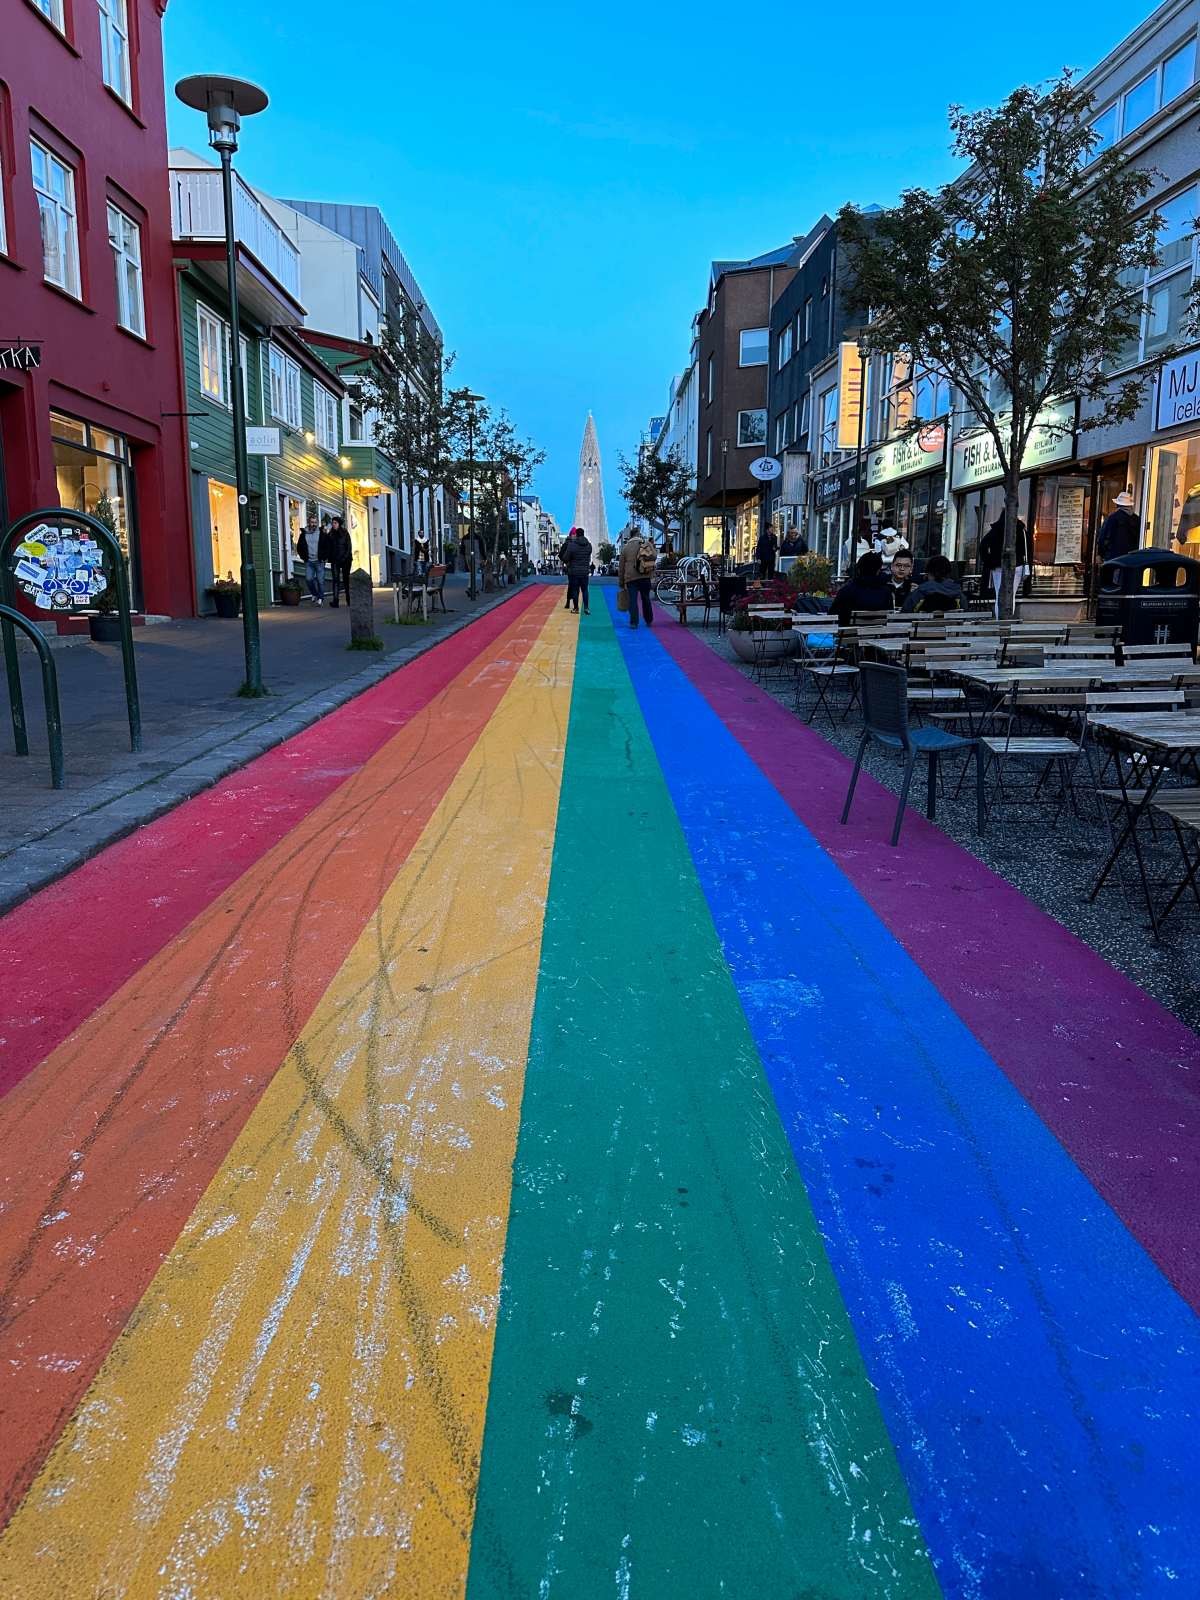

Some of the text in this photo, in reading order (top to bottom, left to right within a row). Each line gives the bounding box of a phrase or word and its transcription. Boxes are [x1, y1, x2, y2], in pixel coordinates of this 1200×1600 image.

[0, 347, 39, 369] TKA
[892, 446, 906, 466] FISH
[907, 447, 912, 460] &
[963, 442, 982, 470] FISH
[983, 441, 991, 461] &
[974, 461, 1002, 477] RESTAURAN
